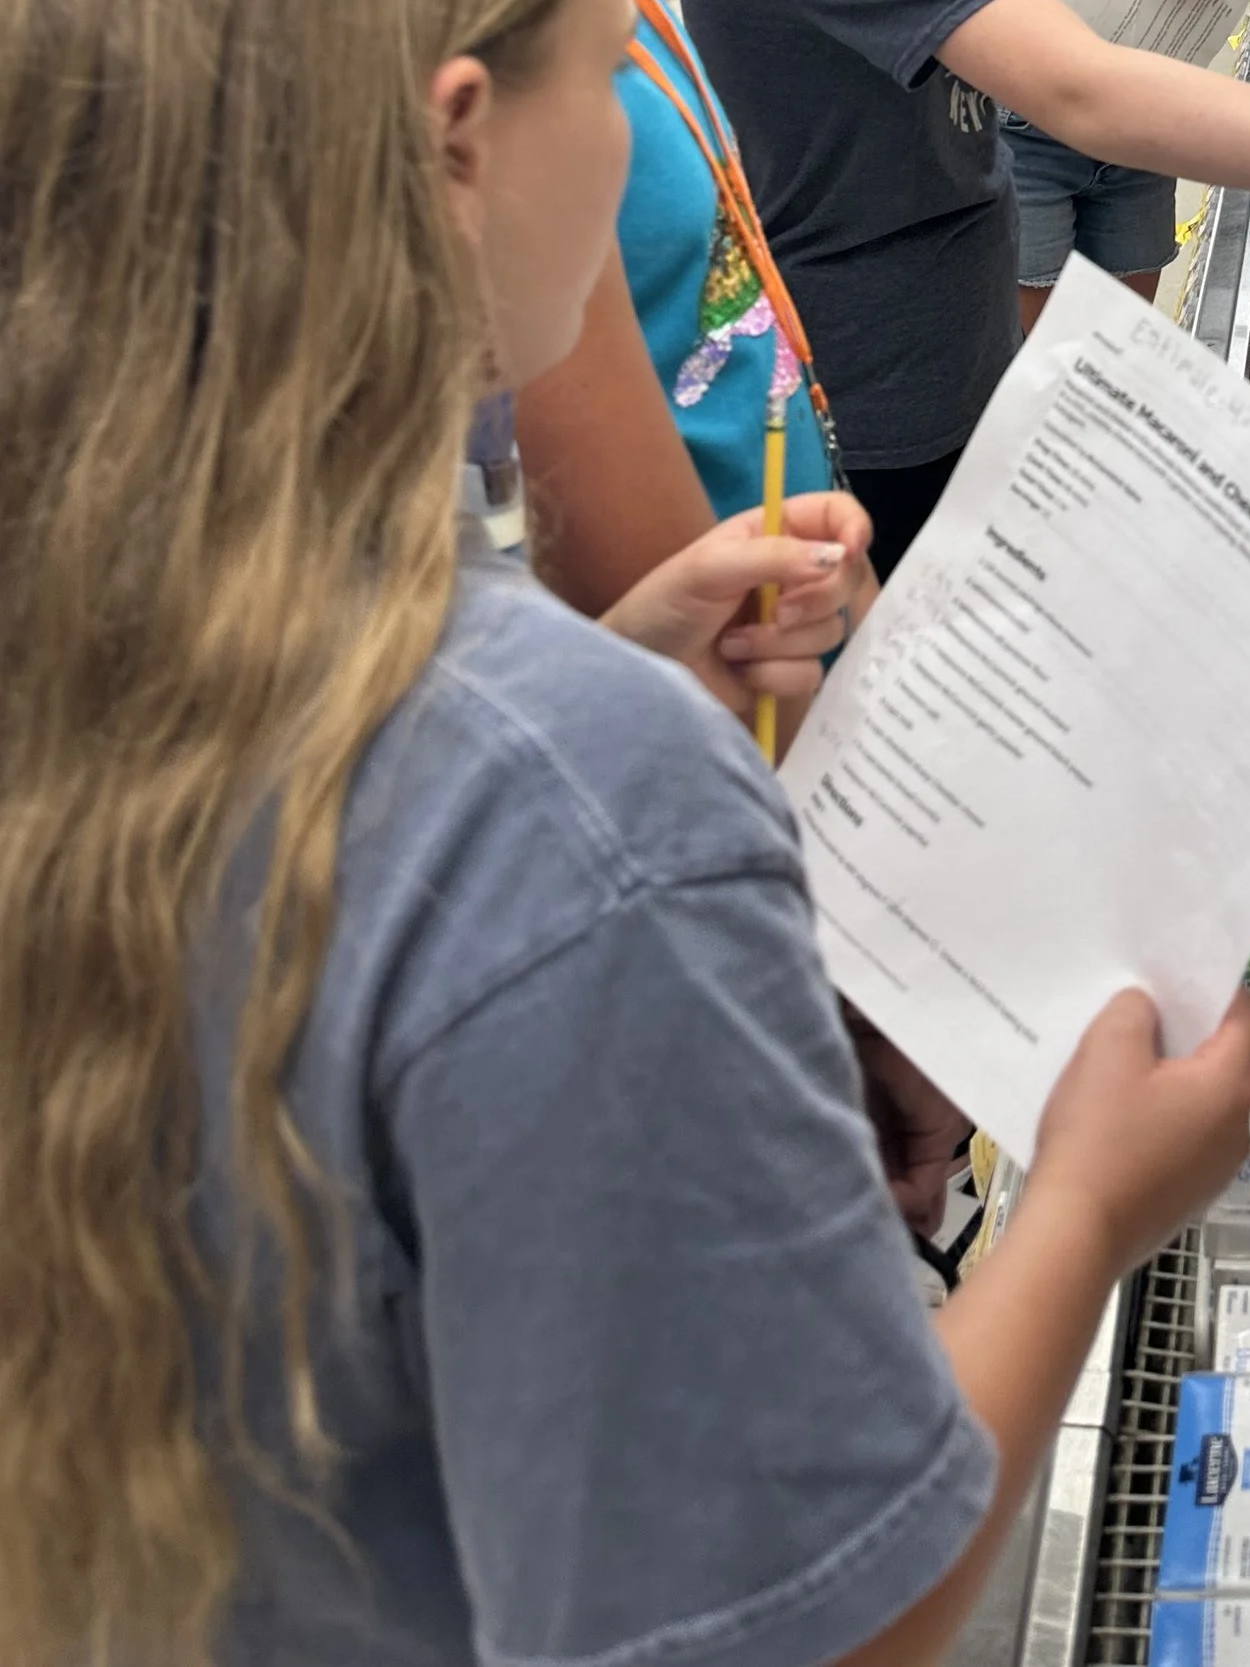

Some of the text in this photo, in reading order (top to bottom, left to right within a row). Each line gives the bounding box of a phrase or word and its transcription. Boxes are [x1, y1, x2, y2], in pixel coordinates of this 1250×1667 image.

[1070, 355, 1138, 414] Ultimate
[1133, 405, 1201, 464] Macaroni
[982, 523, 1049, 584] Ingredients
[1200, 1436, 1224, 1505] Lucerne
